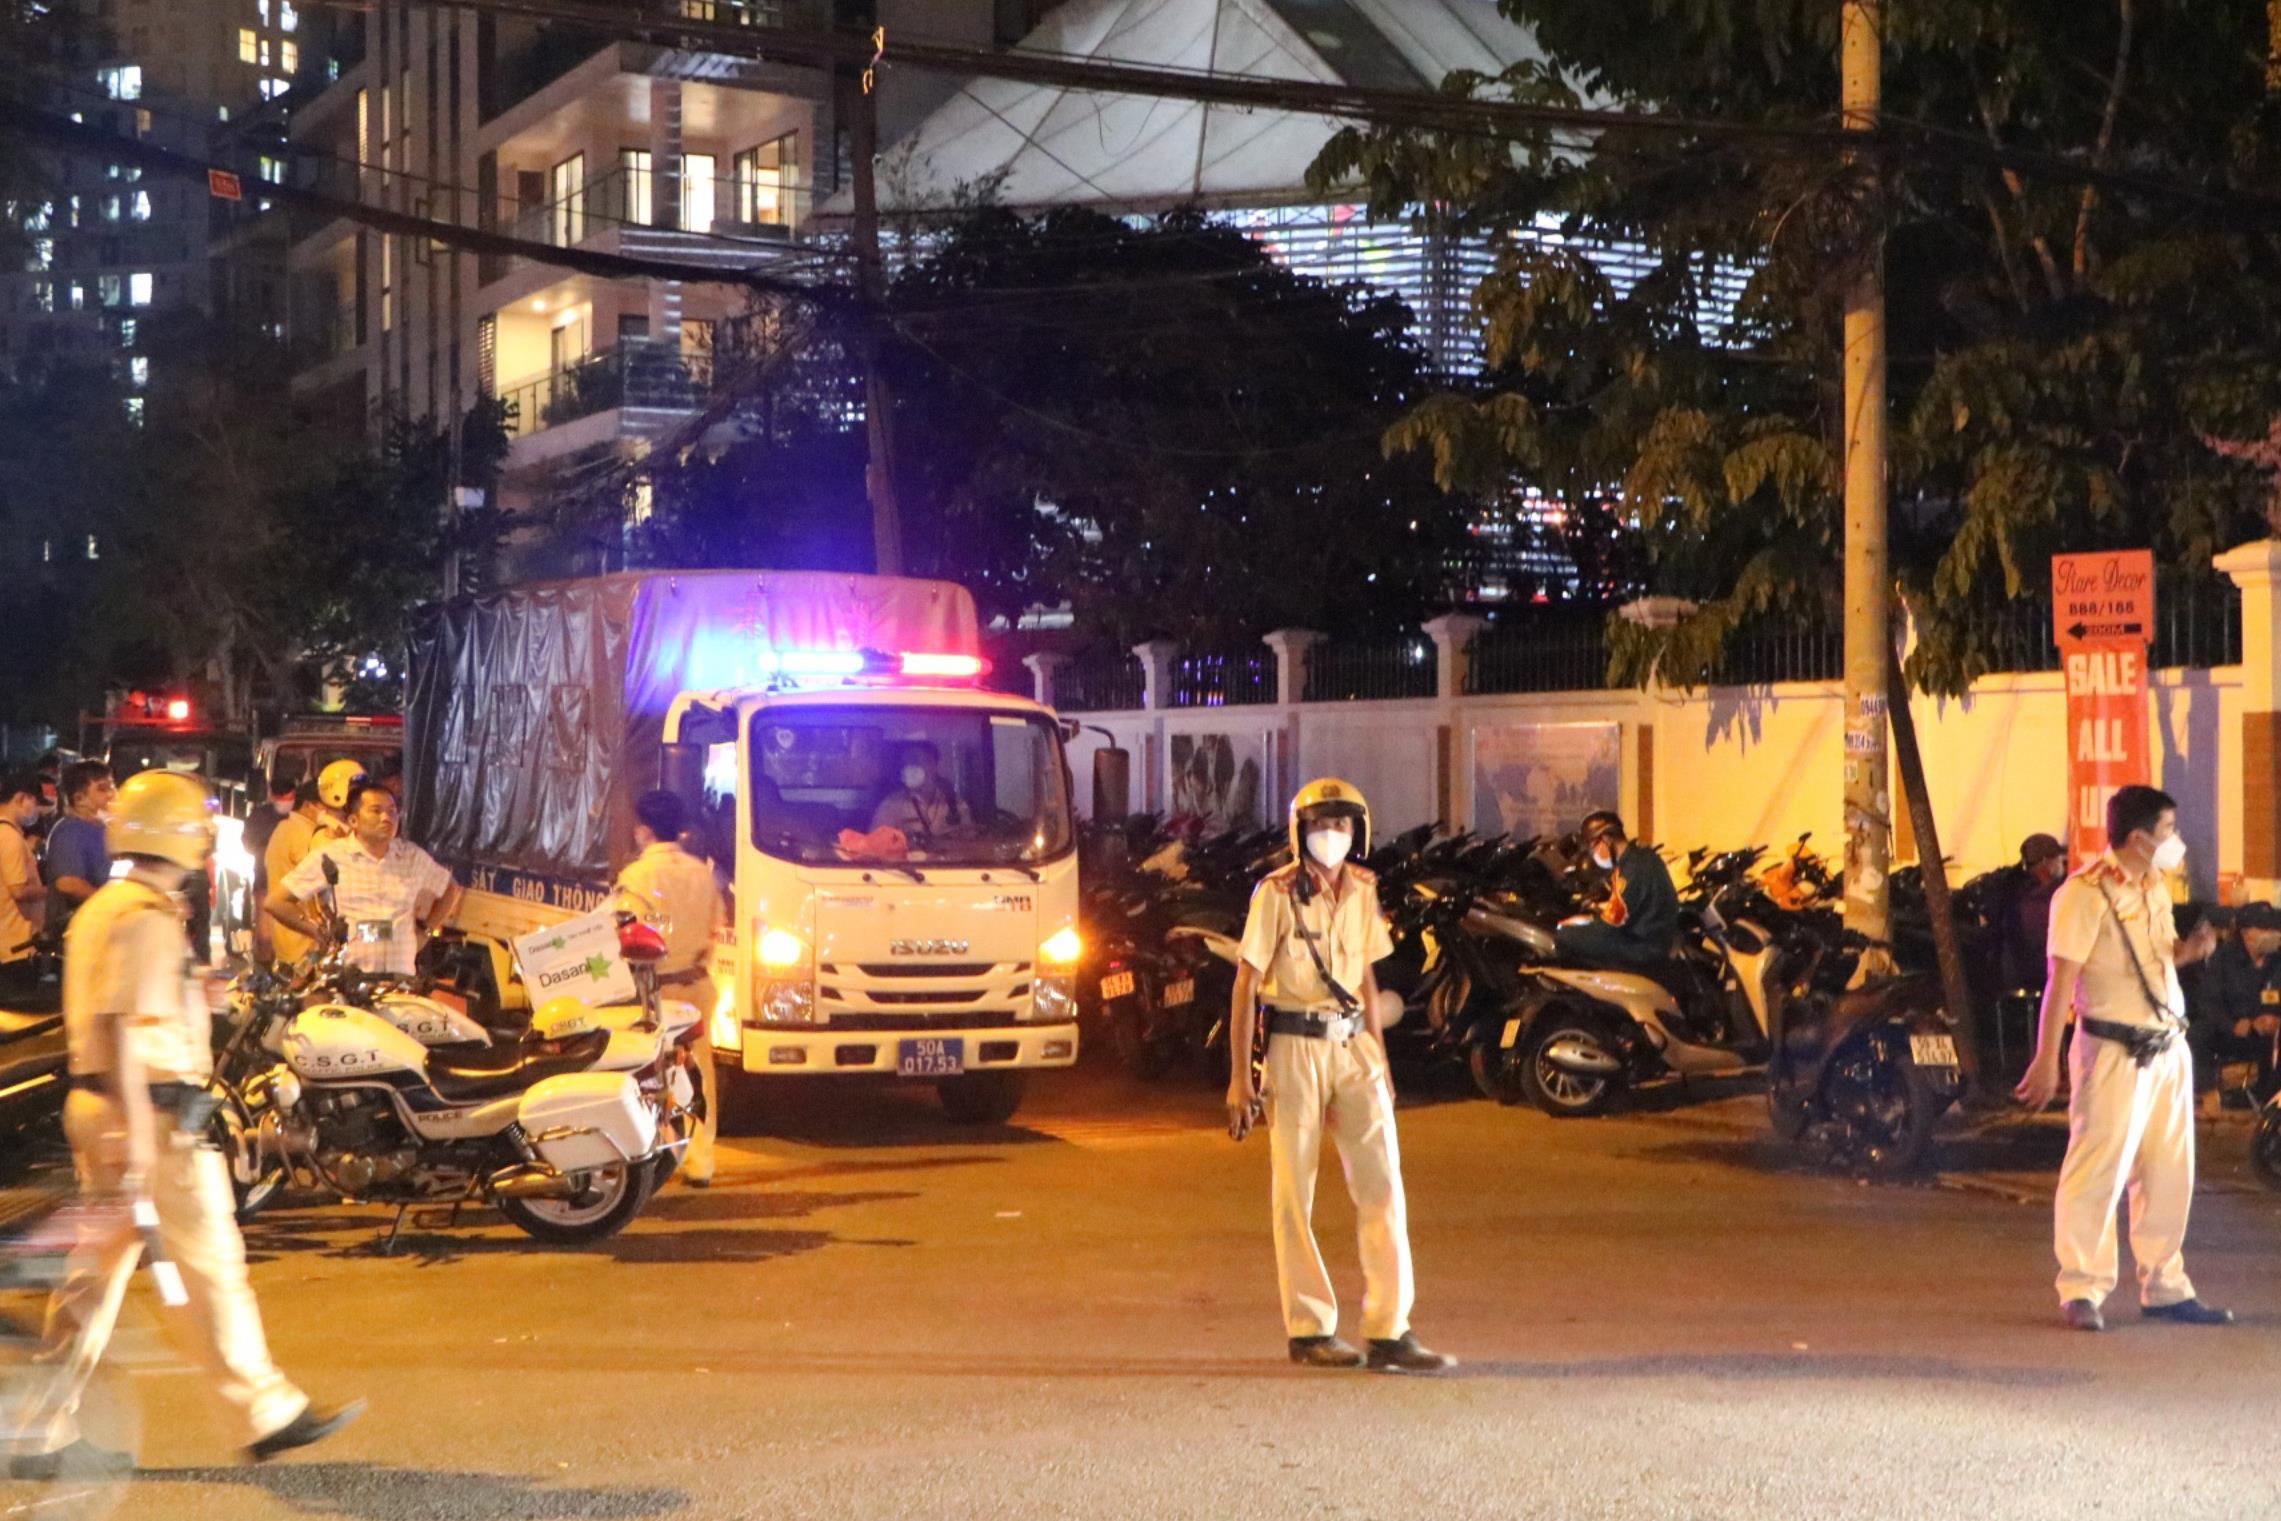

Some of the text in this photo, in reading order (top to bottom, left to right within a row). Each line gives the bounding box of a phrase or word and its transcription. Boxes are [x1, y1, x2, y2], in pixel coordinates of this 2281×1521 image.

[2068, 652, 2136, 696] SALE
[2077, 719, 2127, 762] ALL
[512, 877, 545, 902] GIAO
[890, 939, 968, 956] ISUZU
[294, 1047, 381, 1068] C.S.G.T
[916, 1040, 946, 1056] 50A
[904, 1056, 957, 1073] 017.53
[417, 1110, 463, 1123] POLICE
